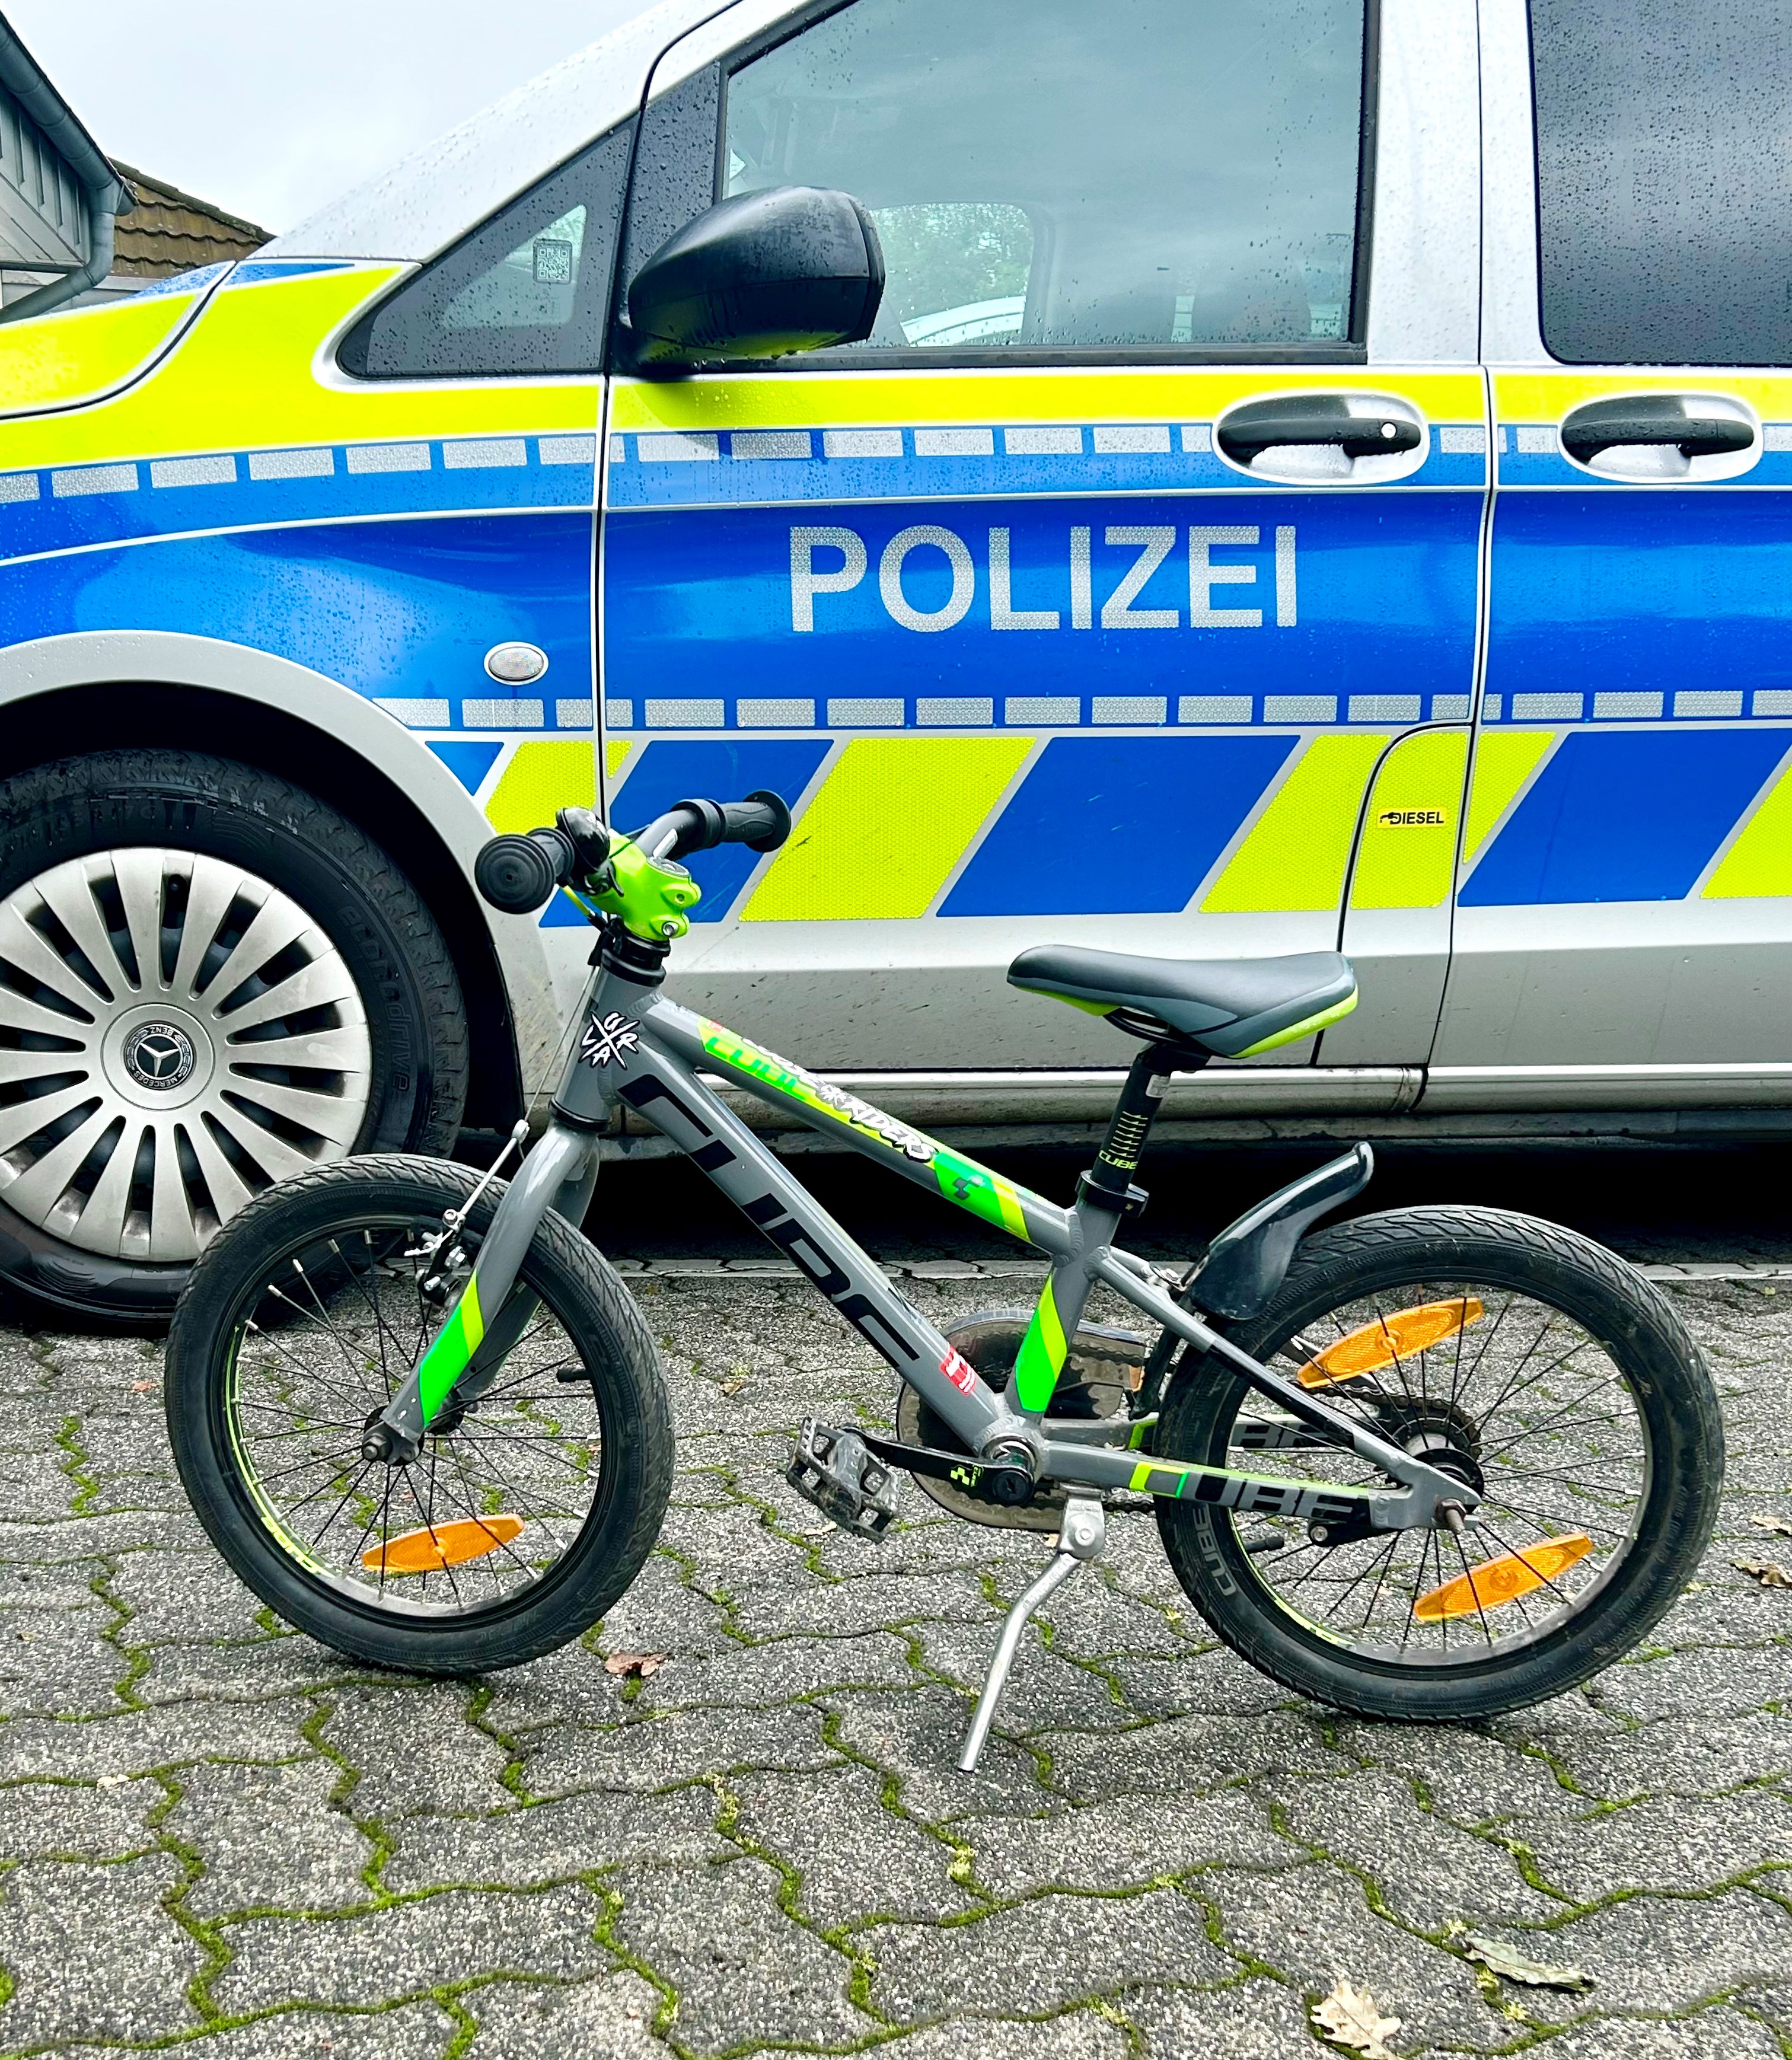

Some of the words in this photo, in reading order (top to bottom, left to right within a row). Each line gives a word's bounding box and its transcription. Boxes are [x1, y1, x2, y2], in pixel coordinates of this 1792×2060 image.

[790, 525, 1297, 633] POLIZEI
[1388, 811, 1445, 825] DIESEL
[149, 1026, 174, 1037] BENZ
[133, 1070, 178, 1088] MERCEDES
[840, 1094, 937, 1161] RIDERS
[1098, 1149, 1139, 1169] CUBE
[1192, 1507, 1236, 1596] CUBE
